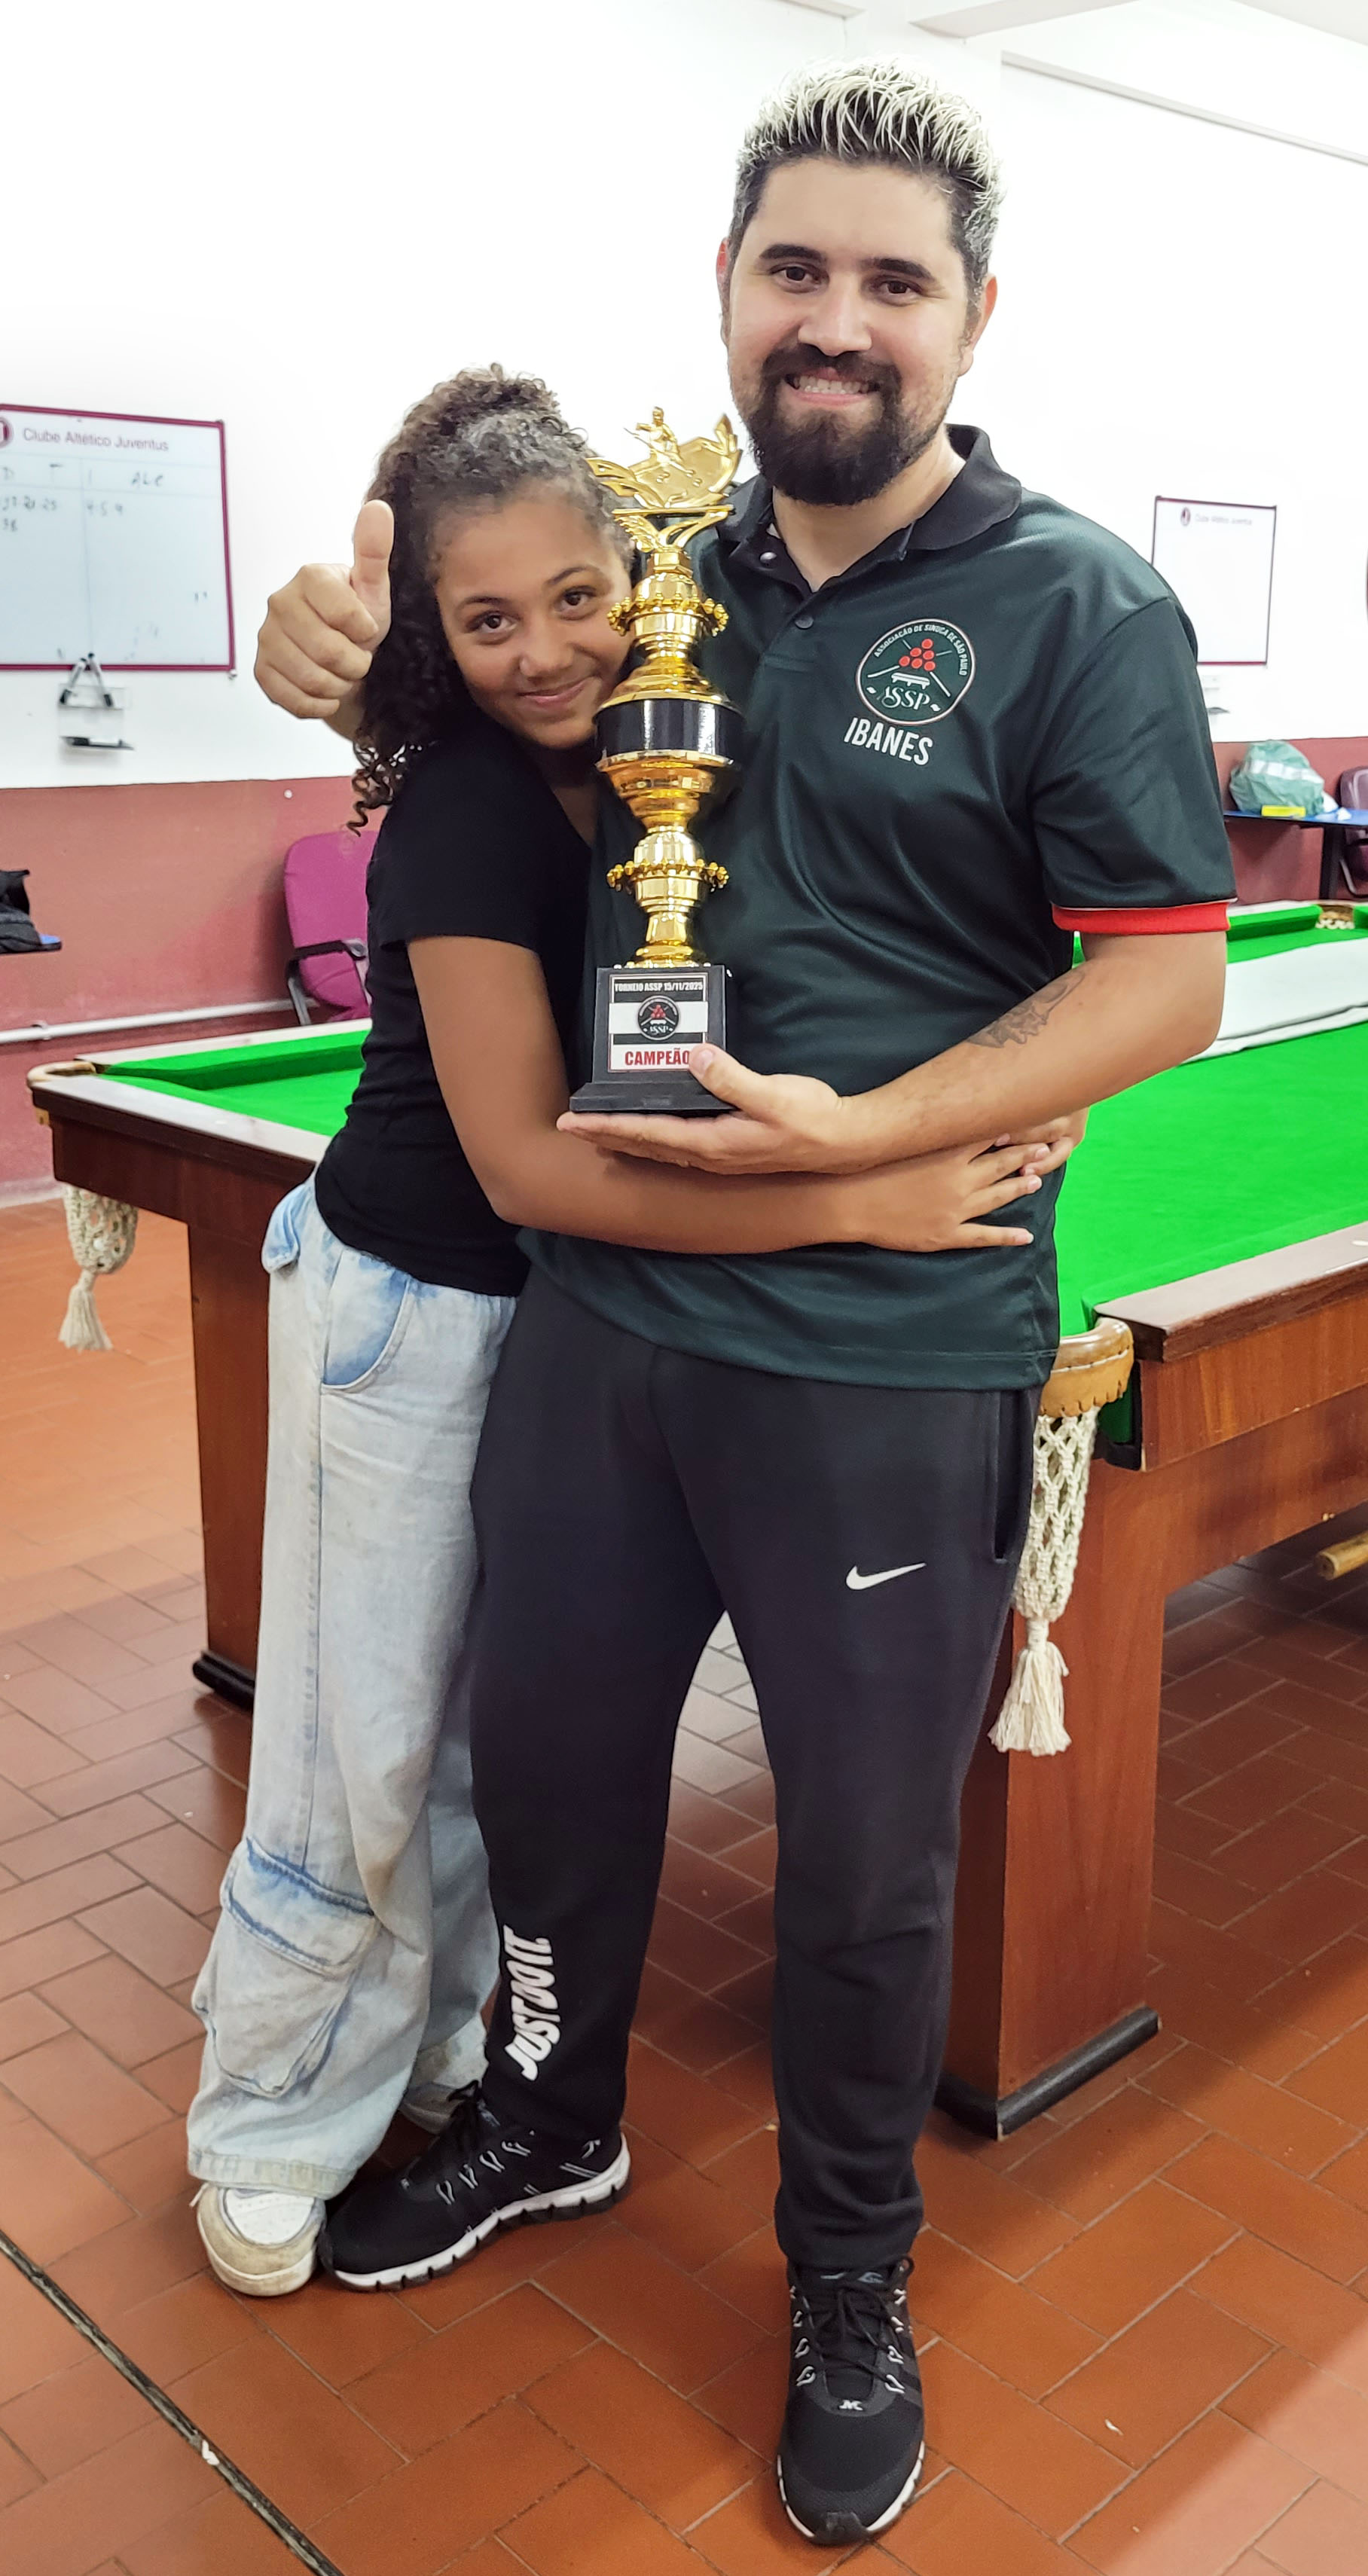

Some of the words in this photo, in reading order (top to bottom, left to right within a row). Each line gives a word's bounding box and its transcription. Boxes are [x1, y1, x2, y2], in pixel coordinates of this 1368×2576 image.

[23, 427, 60, 443] Clube
[115, 436, 169, 451] Juventus
[914, 624, 924, 633] DE
[924, 624, 949, 636] SINUCA
[947, 631, 958, 642] DE
[874, 627, 913, 658] ASSOCIAÇÃO
[954, 639, 966, 655] SÃO
[959, 655, 968, 676] PAULO
[844, 717, 933, 766] IBANES
[615, 982, 644, 992] TORNEIO
[644, 982, 663, 991] ASSP
[624, 1048, 689, 1066] CAMPEÃO
